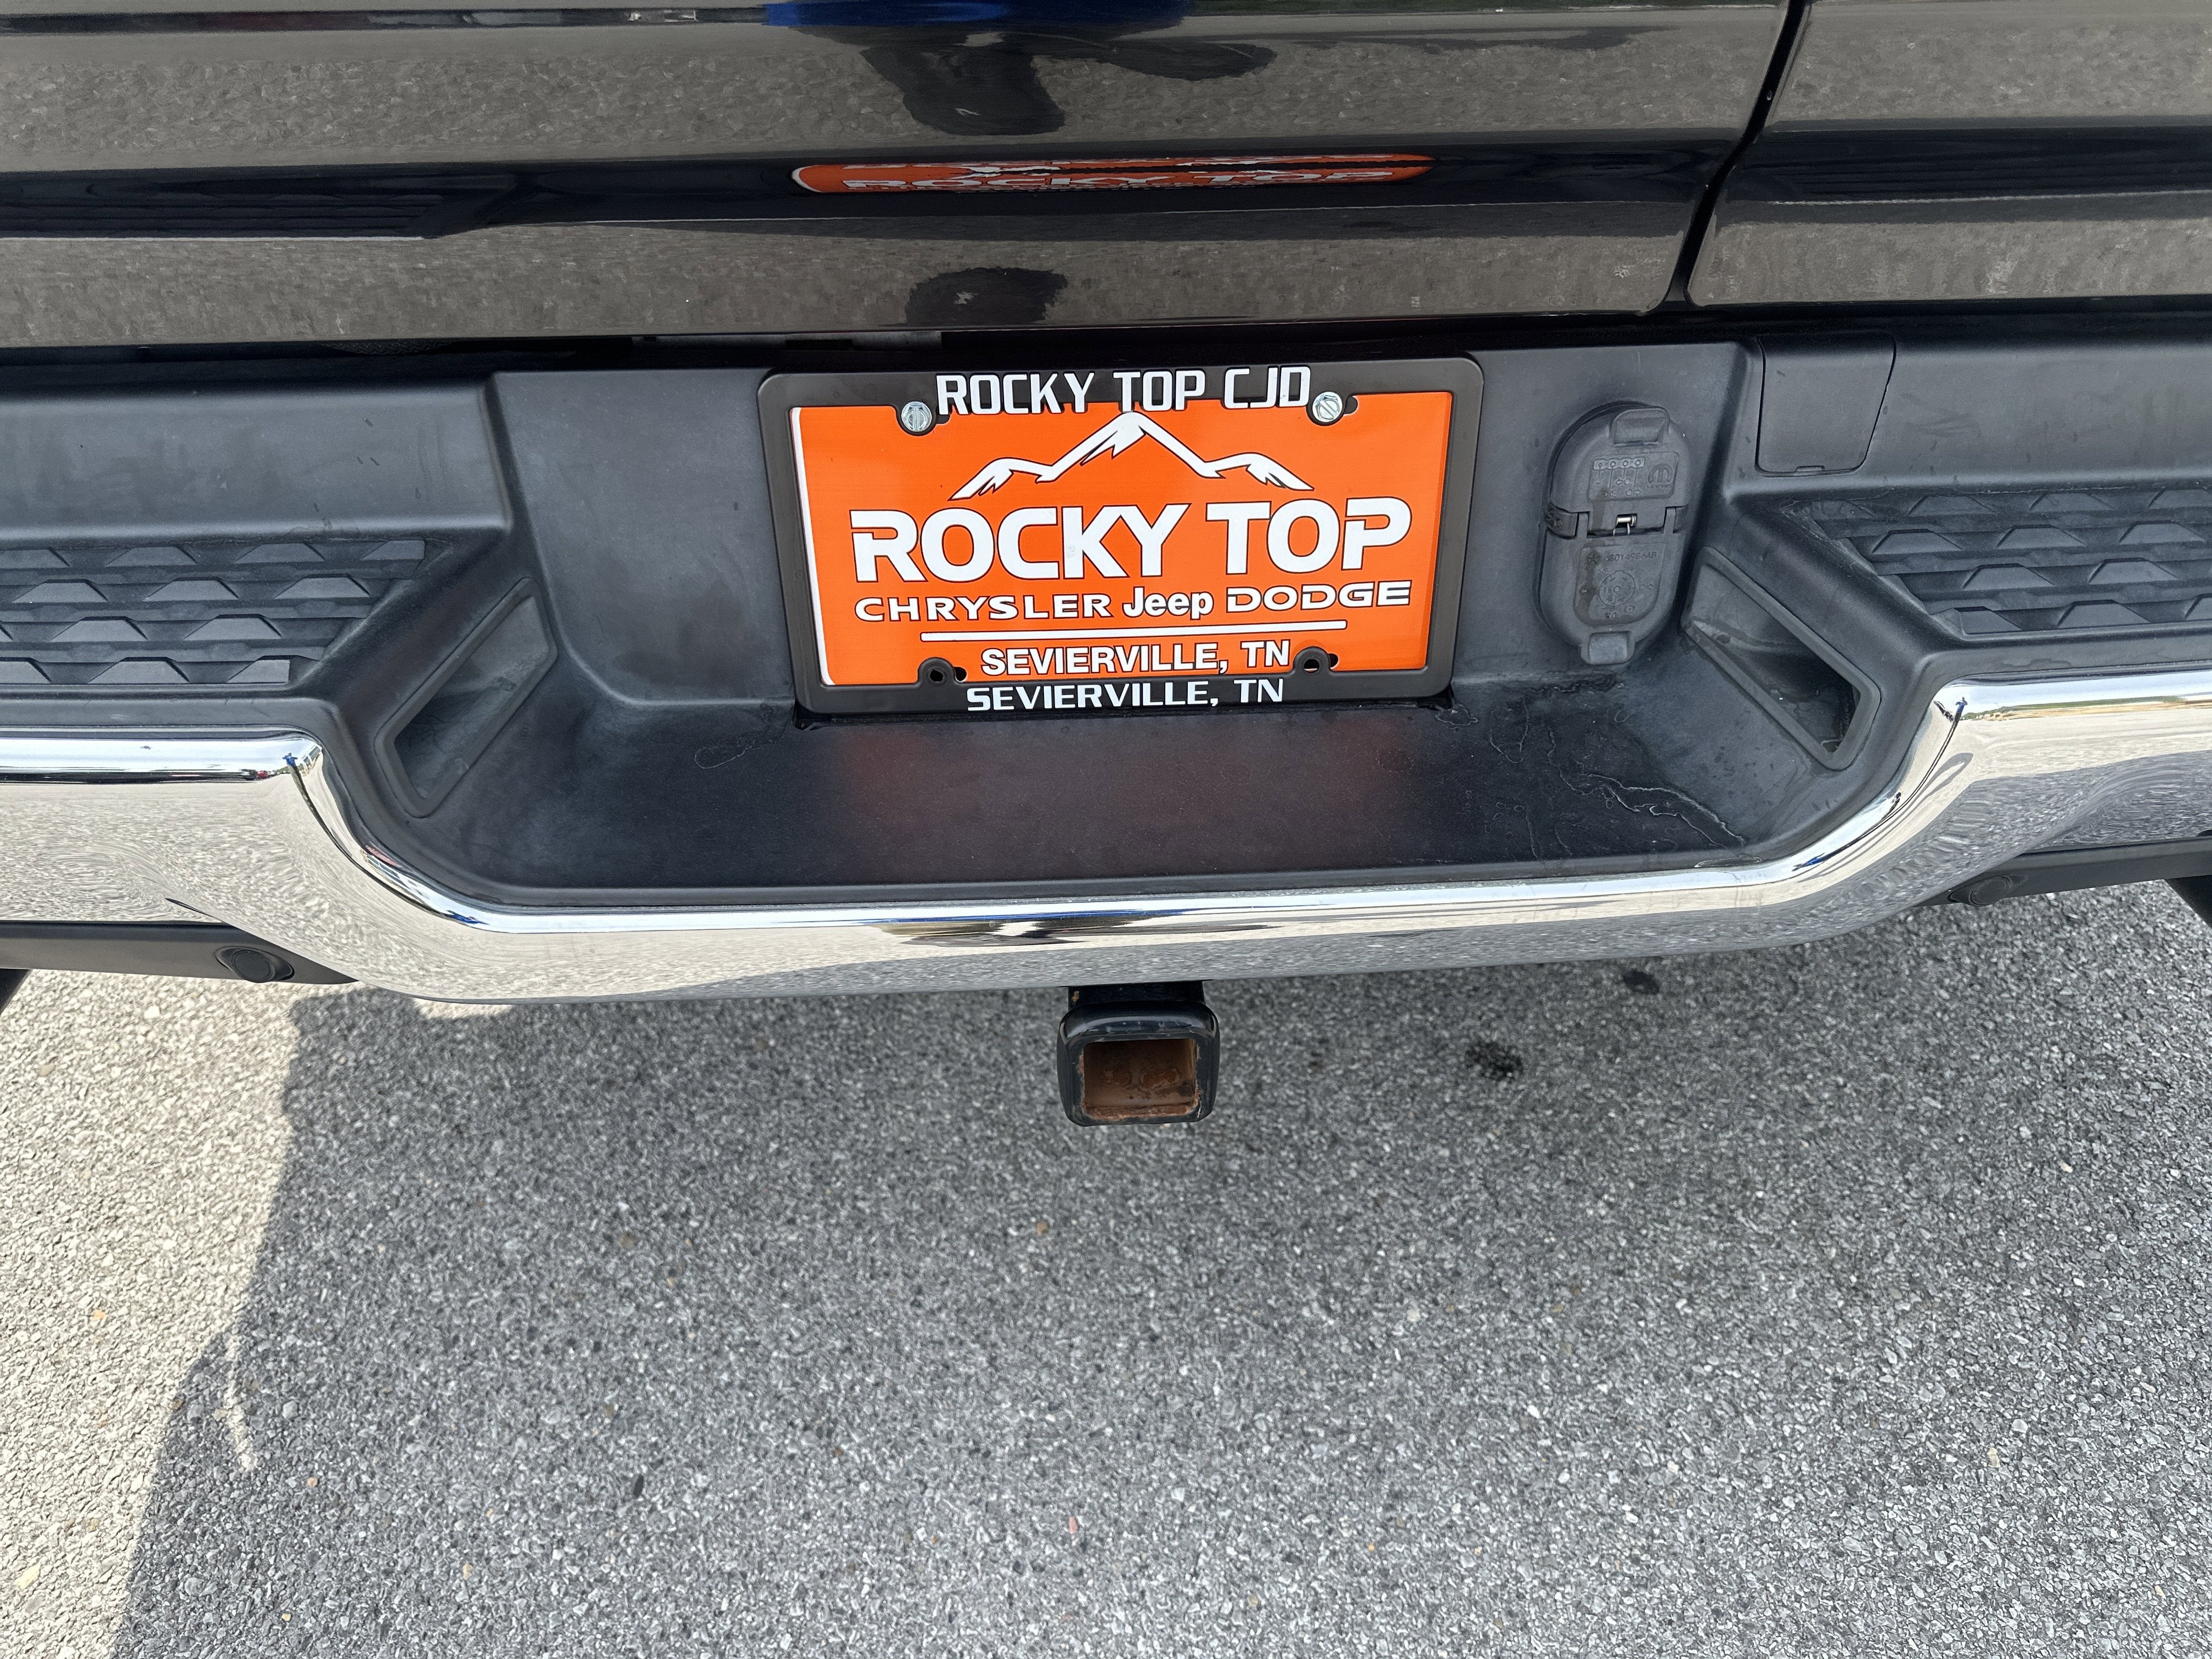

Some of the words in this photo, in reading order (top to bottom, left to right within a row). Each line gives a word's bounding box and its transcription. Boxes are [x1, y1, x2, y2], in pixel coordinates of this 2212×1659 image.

[842, 176, 1173, 188] ROCKY
[1194, 172, 1393, 182] TOP
[936, 373, 1095, 415] ROCKY
[1113, 370, 1205, 413] TOP
[1224, 366, 1311, 409] CJD
[850, 504, 1189, 582] ROCKY
[1206, 498, 1411, 574] TOP
[855, 594, 1111, 621] CHRYSLER
[1122, 587, 1214, 619] Jeep
[1227, 581, 1410, 612] DODGE
[982, 643, 1227, 675] SEVIERVILLE,
[1242, 640, 1289, 667] TN
[967, 681, 1220, 711] SEVIERVILLE,
[1233, 679, 1283, 703] TN
